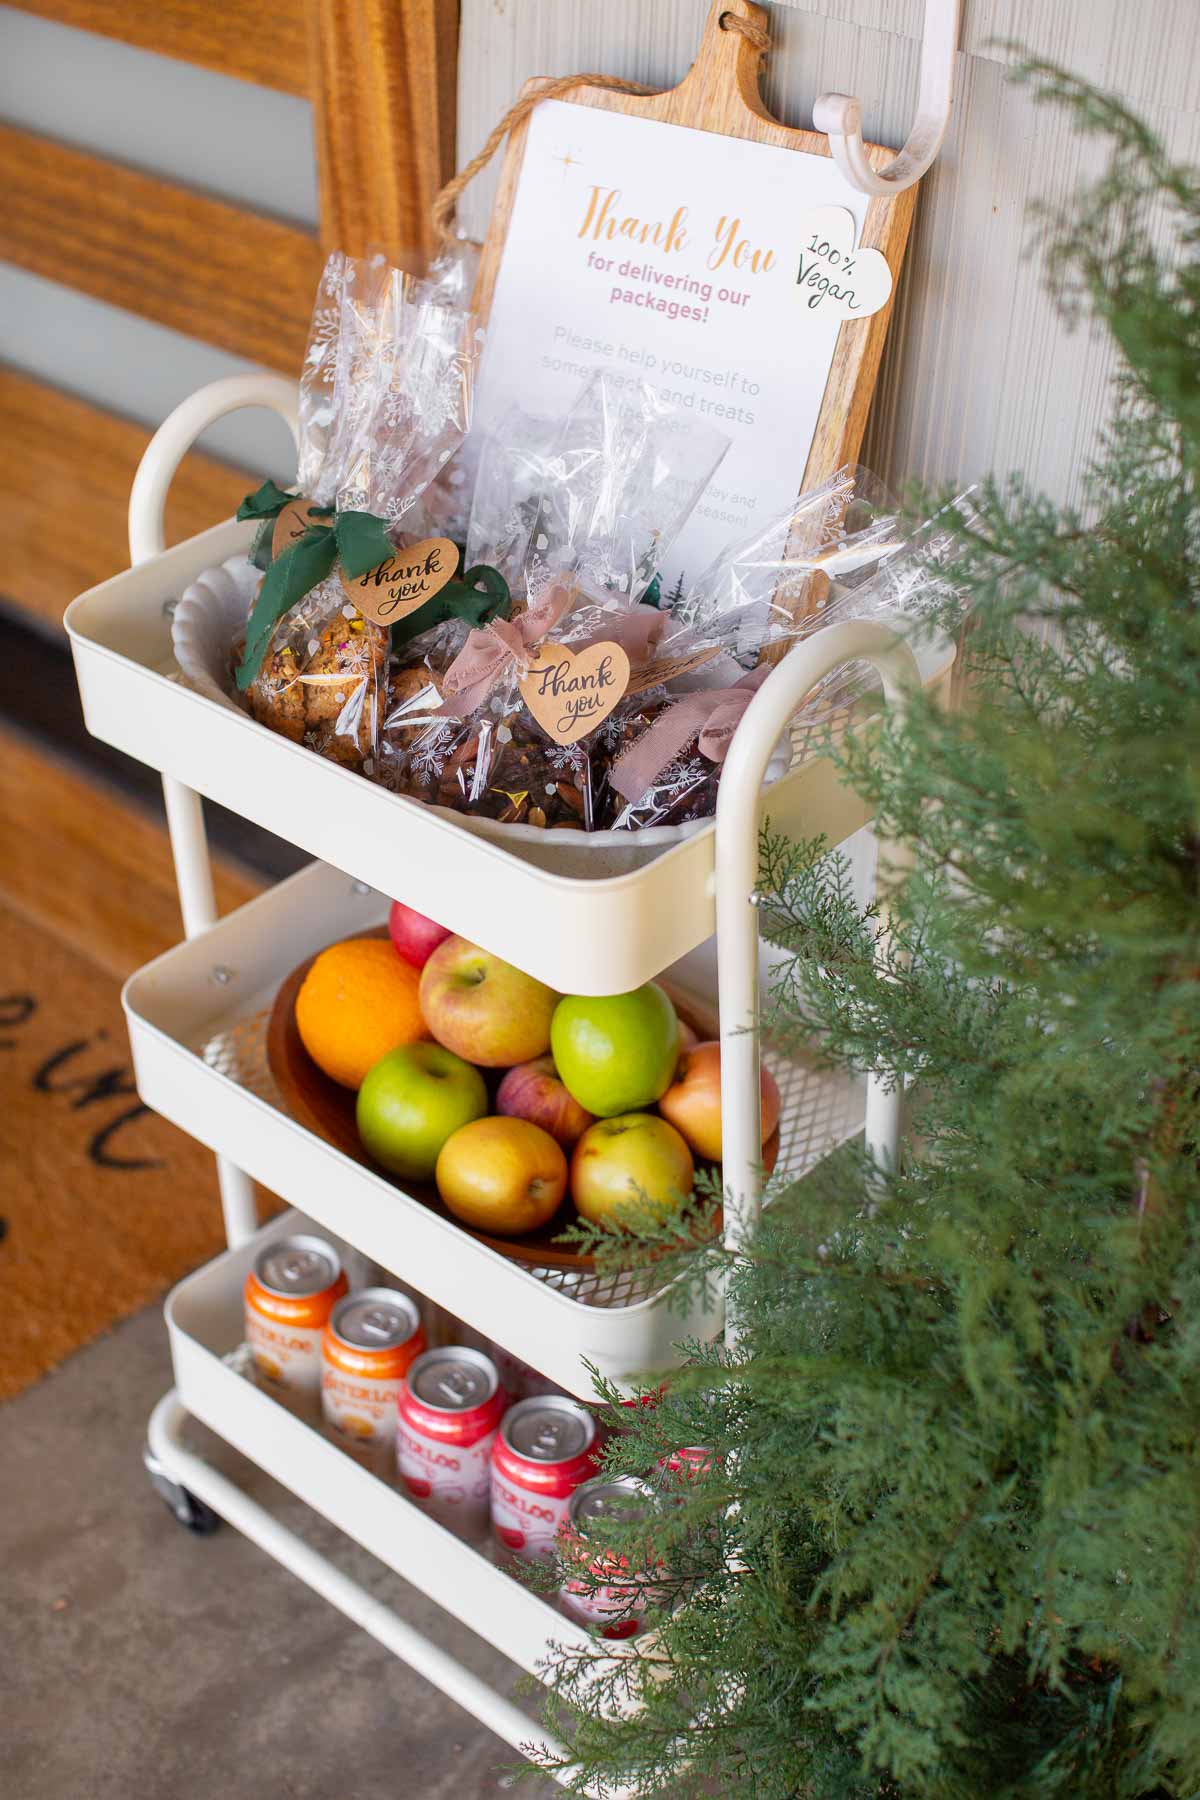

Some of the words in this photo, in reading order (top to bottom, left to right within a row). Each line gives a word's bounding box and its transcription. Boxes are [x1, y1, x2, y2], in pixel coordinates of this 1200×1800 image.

[577, 185, 689, 254] Thank
[705, 215, 777, 275] You
[587, 251, 615, 272] for
[618, 260, 713, 303] delivering
[717, 287, 751, 307] our
[806, 234, 856, 276] 100%
[609, 287, 711, 323] packages!
[796, 253, 862, 309] Vegan
[553, 325, 615, 356] Please
[619, 343, 657, 369] help
[661, 358, 740, 390] yourself
[741, 376, 761, 396] to
[540, 354, 590, 378] some
[659, 387, 695, 408] and
[699, 397, 756, 425] treats
[377, 578, 431, 616] you
[528, 655, 617, 697] Thank
[556, 692, 605, 734] you
